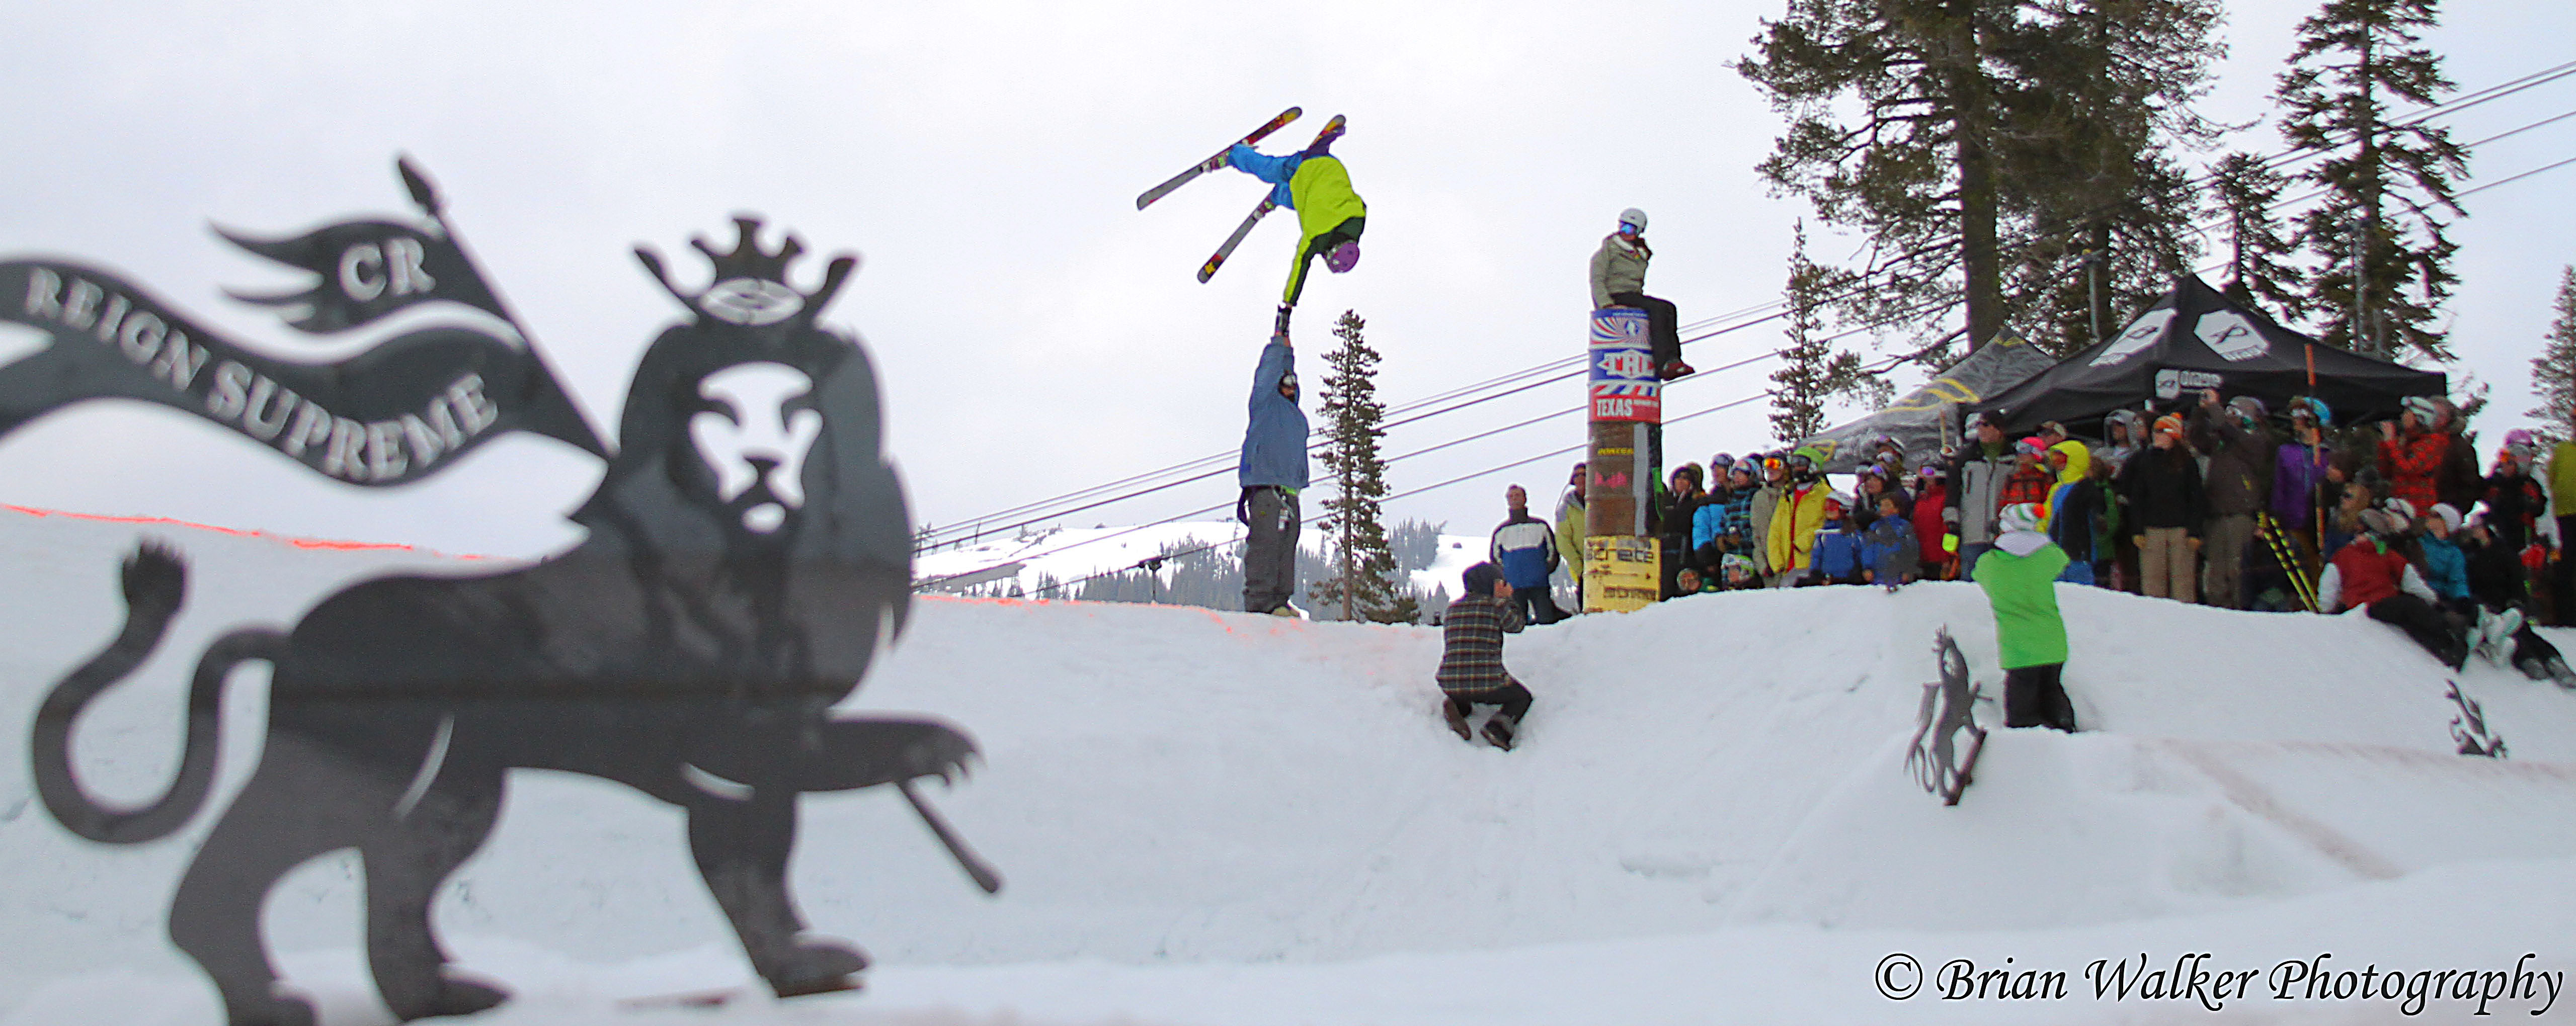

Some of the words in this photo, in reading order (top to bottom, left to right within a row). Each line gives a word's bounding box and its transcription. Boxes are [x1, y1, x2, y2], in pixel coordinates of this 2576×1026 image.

[339, 238, 436, 301] CR
[25, 267, 210, 391] REIGN
[207, 360, 498, 482] SUPREME
[1596, 398, 1633, 417] TEXAS
